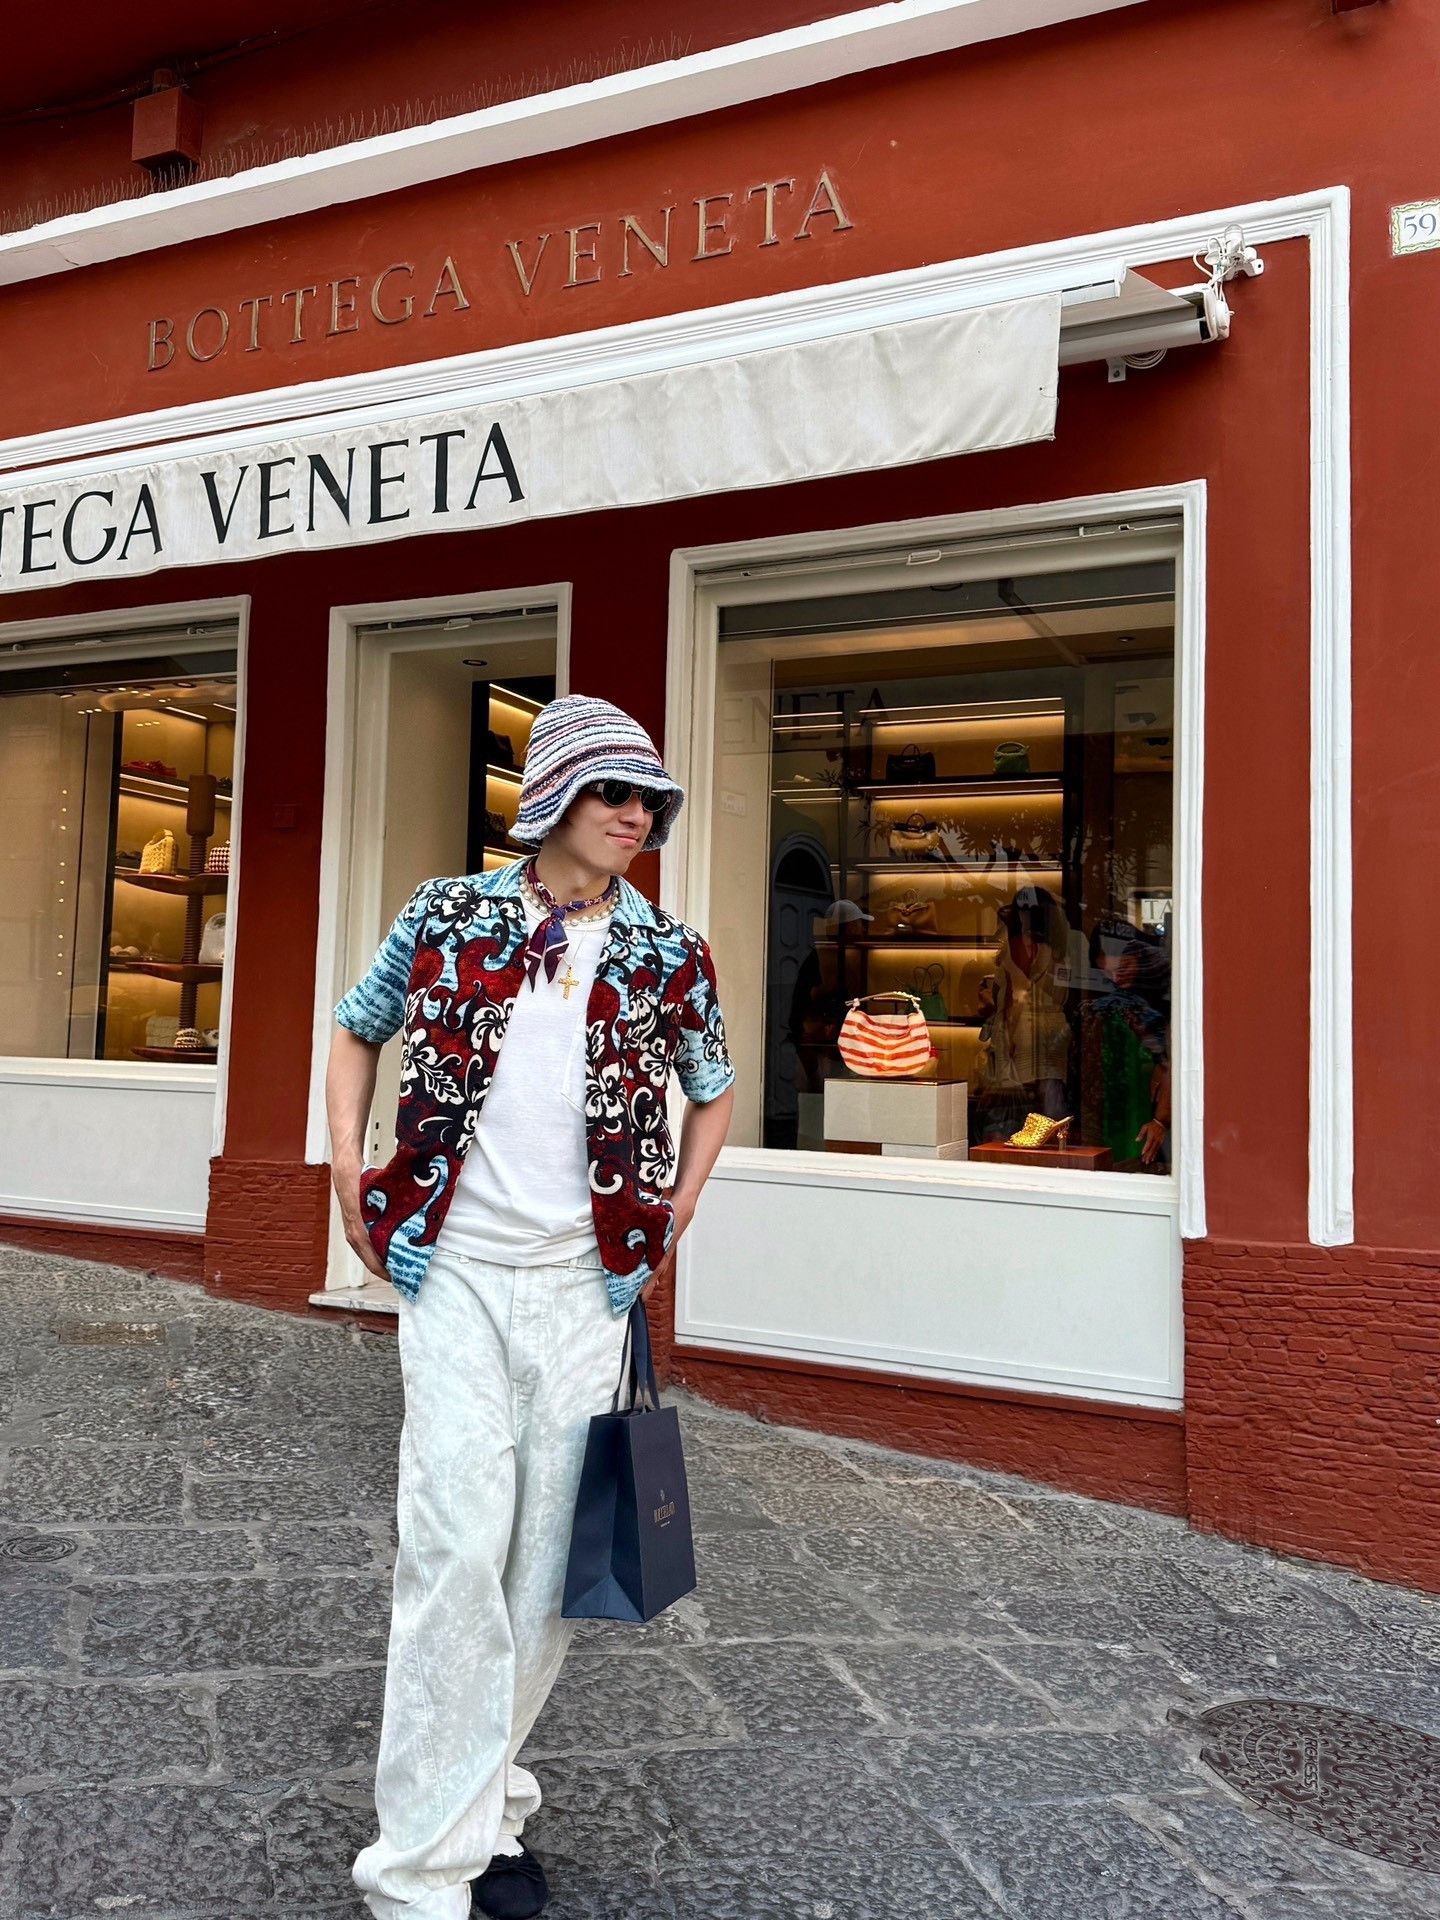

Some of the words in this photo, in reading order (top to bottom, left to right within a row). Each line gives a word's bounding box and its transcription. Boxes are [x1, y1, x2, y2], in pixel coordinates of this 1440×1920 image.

[147, 256, 470, 372] BOTTEGA
[504, 171, 854, 297] VENETA
[1403, 213, 1436, 240] 59
[200, 421, 525, 545] VENETA
